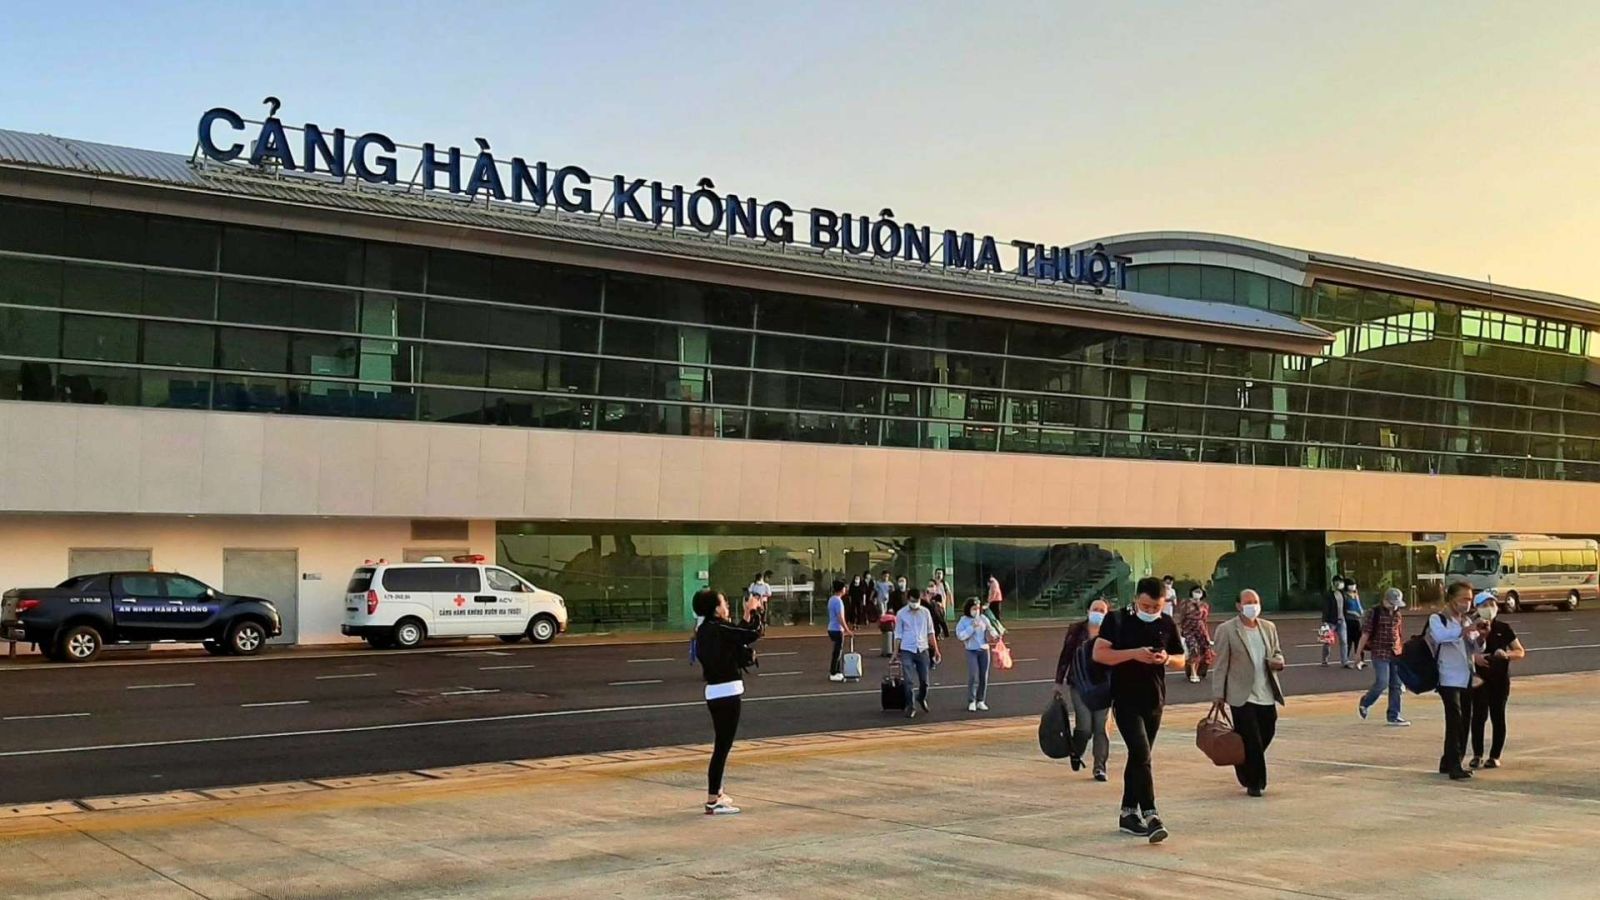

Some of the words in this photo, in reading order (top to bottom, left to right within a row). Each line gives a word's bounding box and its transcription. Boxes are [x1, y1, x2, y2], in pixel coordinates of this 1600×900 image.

[198, 96, 397, 185] CẢNG
[422, 137, 592, 213] HÀNG
[614, 175, 794, 244] KHÔNG
[810, 208, 930, 264] BUÔN
[943, 229, 1002, 273] MA
[1011, 240, 1133, 295] THUỘT
